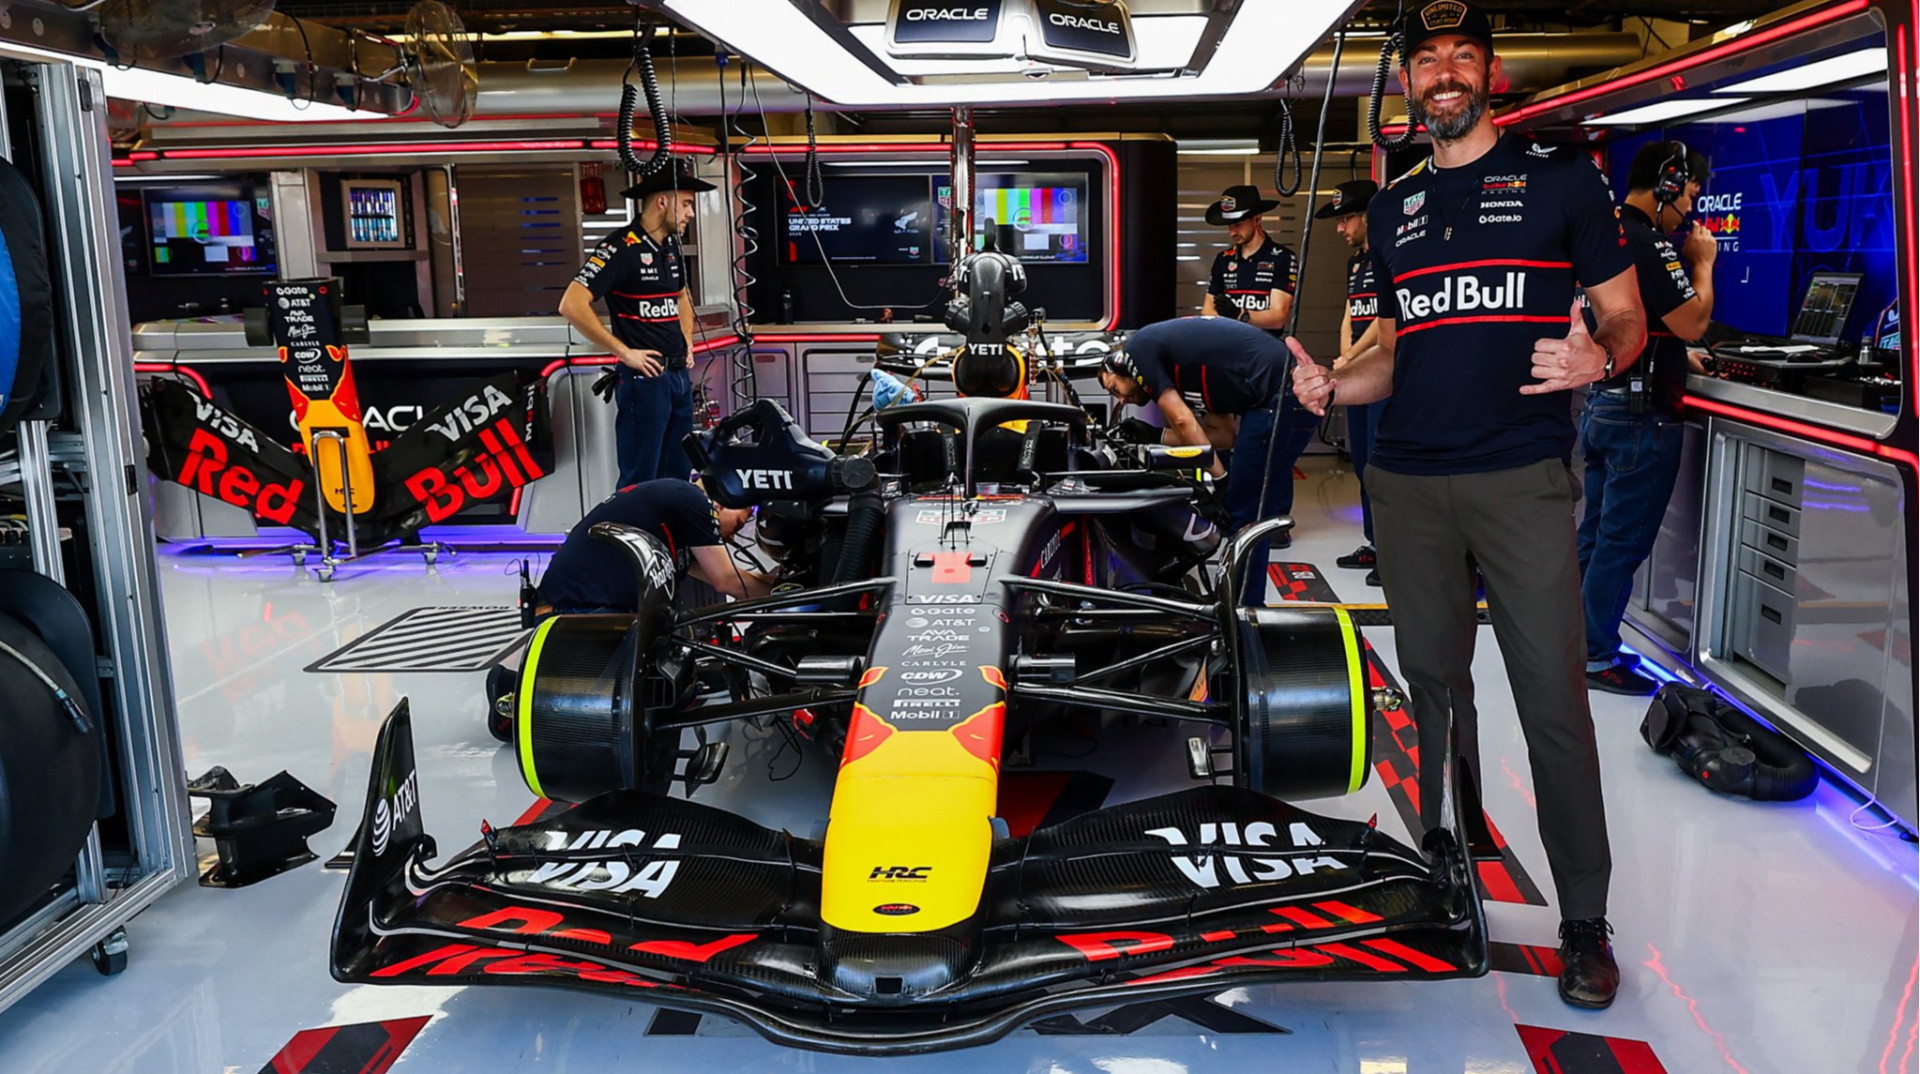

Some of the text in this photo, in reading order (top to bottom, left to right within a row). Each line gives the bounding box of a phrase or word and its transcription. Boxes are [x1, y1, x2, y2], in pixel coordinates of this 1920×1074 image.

[906, 8, 988, 21] ORACLE
[1049, 13, 1120, 35] ORACLE
[1484, 174, 1528, 182] ORACLE
[1697, 192, 1742, 212] ORACLE
[1488, 214, 1522, 223] Gate.io
[1395, 230, 1426, 247] ORACLE
[291, 299, 311, 307] AT&T
[1396, 277, 1451, 321] Red
[1457, 272, 1526, 310] Bull
[295, 351, 315, 359] CDW
[968, 343, 1003, 355] YETI
[424, 384, 512, 442] VISA
[187, 390, 258, 453] VISA
[178, 417, 544, 525] Red Bull
[736, 469, 793, 490] YETI
[914, 594, 975, 603] VISA
[927, 607, 976, 615] Gate
[932, 618, 976, 627] AT&T
[900, 671, 949, 680] CDW
[893, 699, 961, 707] PIRELLI
[890, 710, 940, 719] Mobil
[393, 768, 416, 831] AT&T
[1143, 821, 1349, 888] VISA
[526, 829, 681, 899] VISA
[869, 866, 933, 879] HRC
